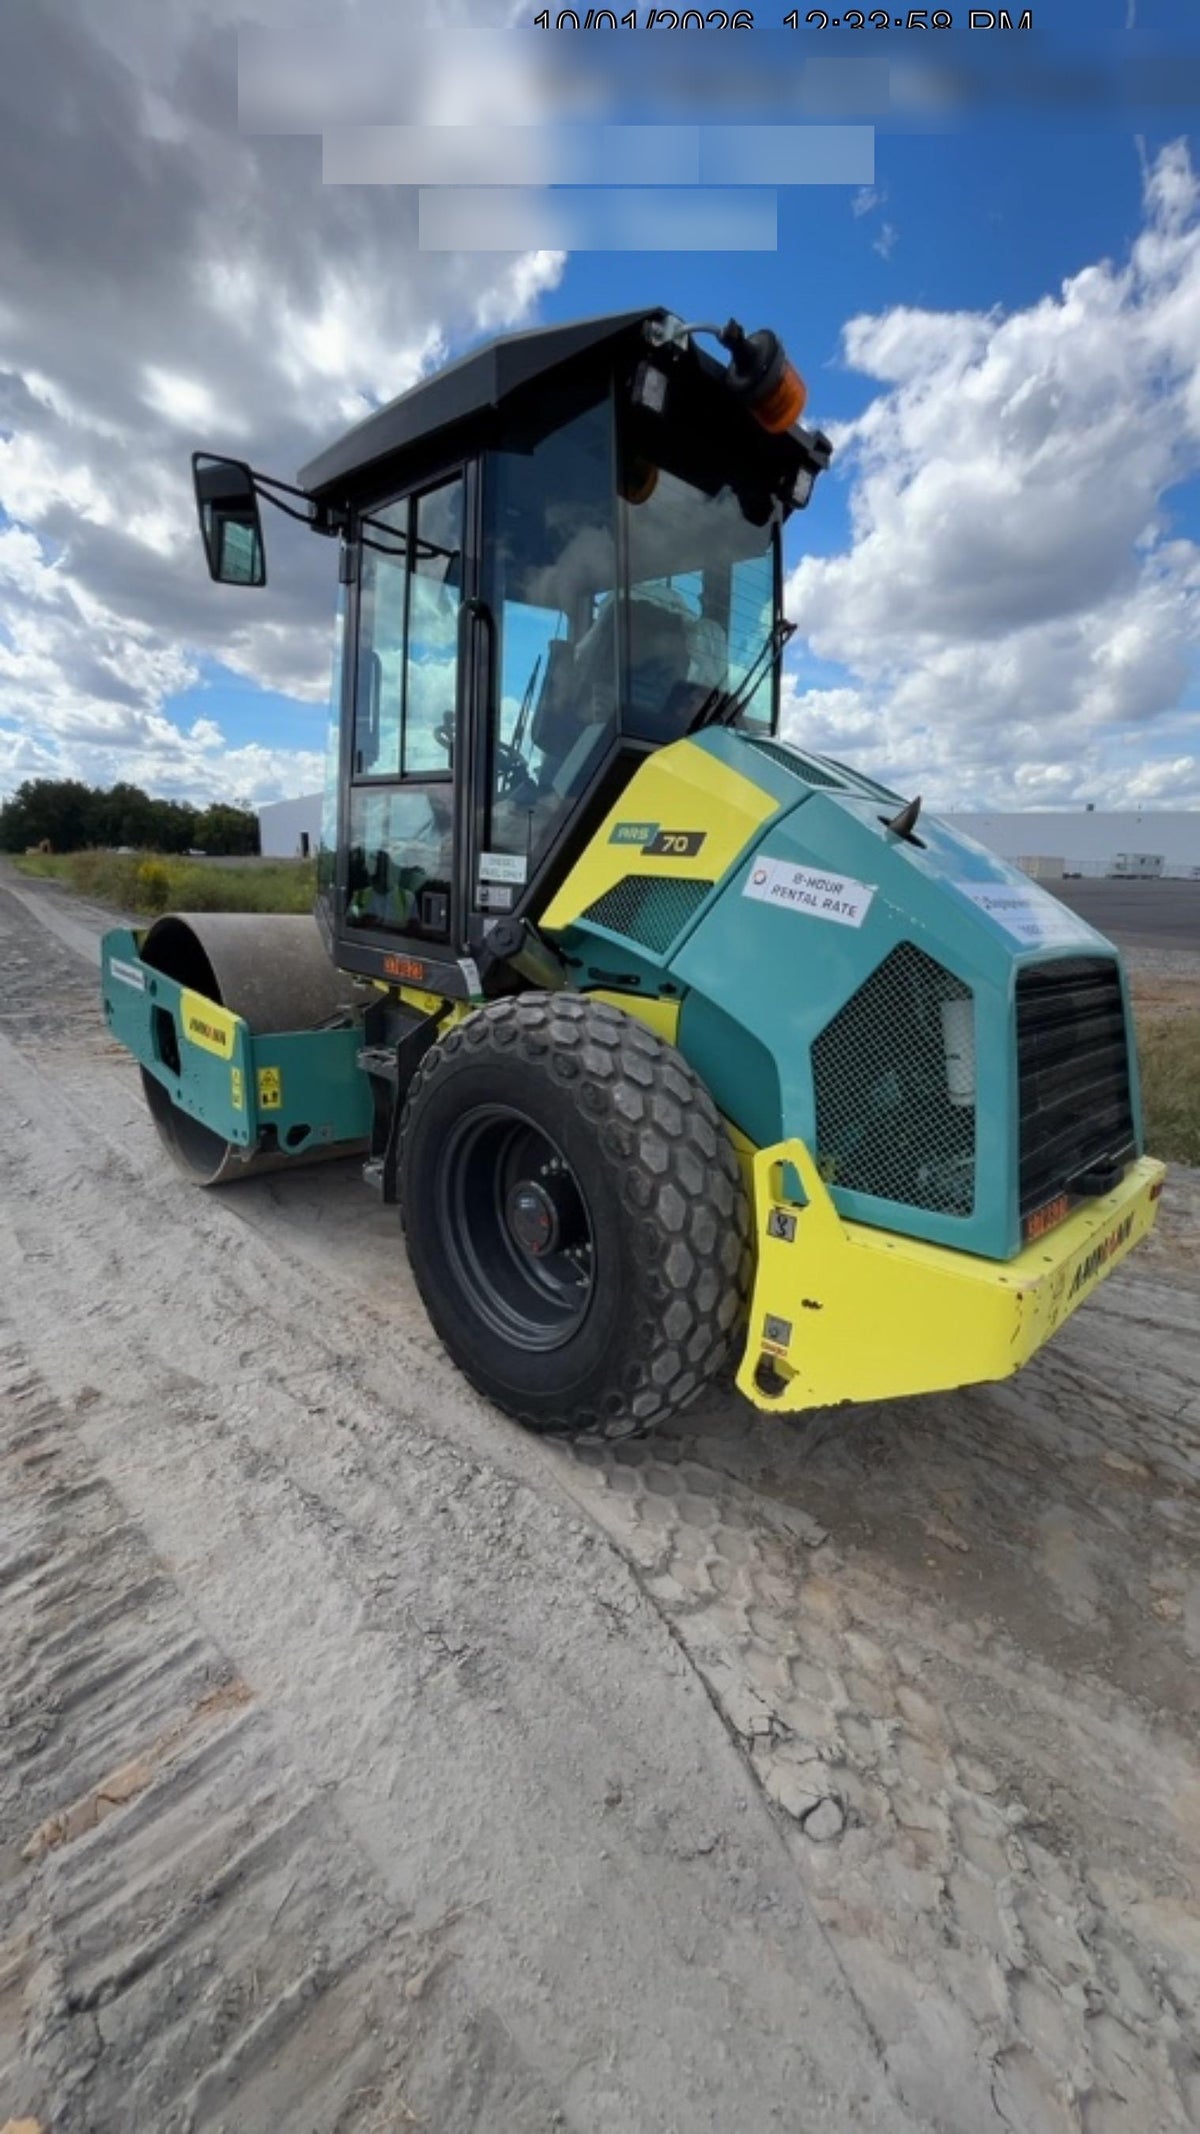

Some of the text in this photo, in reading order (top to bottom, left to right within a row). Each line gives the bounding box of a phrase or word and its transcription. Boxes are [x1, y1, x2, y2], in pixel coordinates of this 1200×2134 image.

[661, 836, 689, 852] 70
[770, 884, 858, 918] RENTAL RATE
